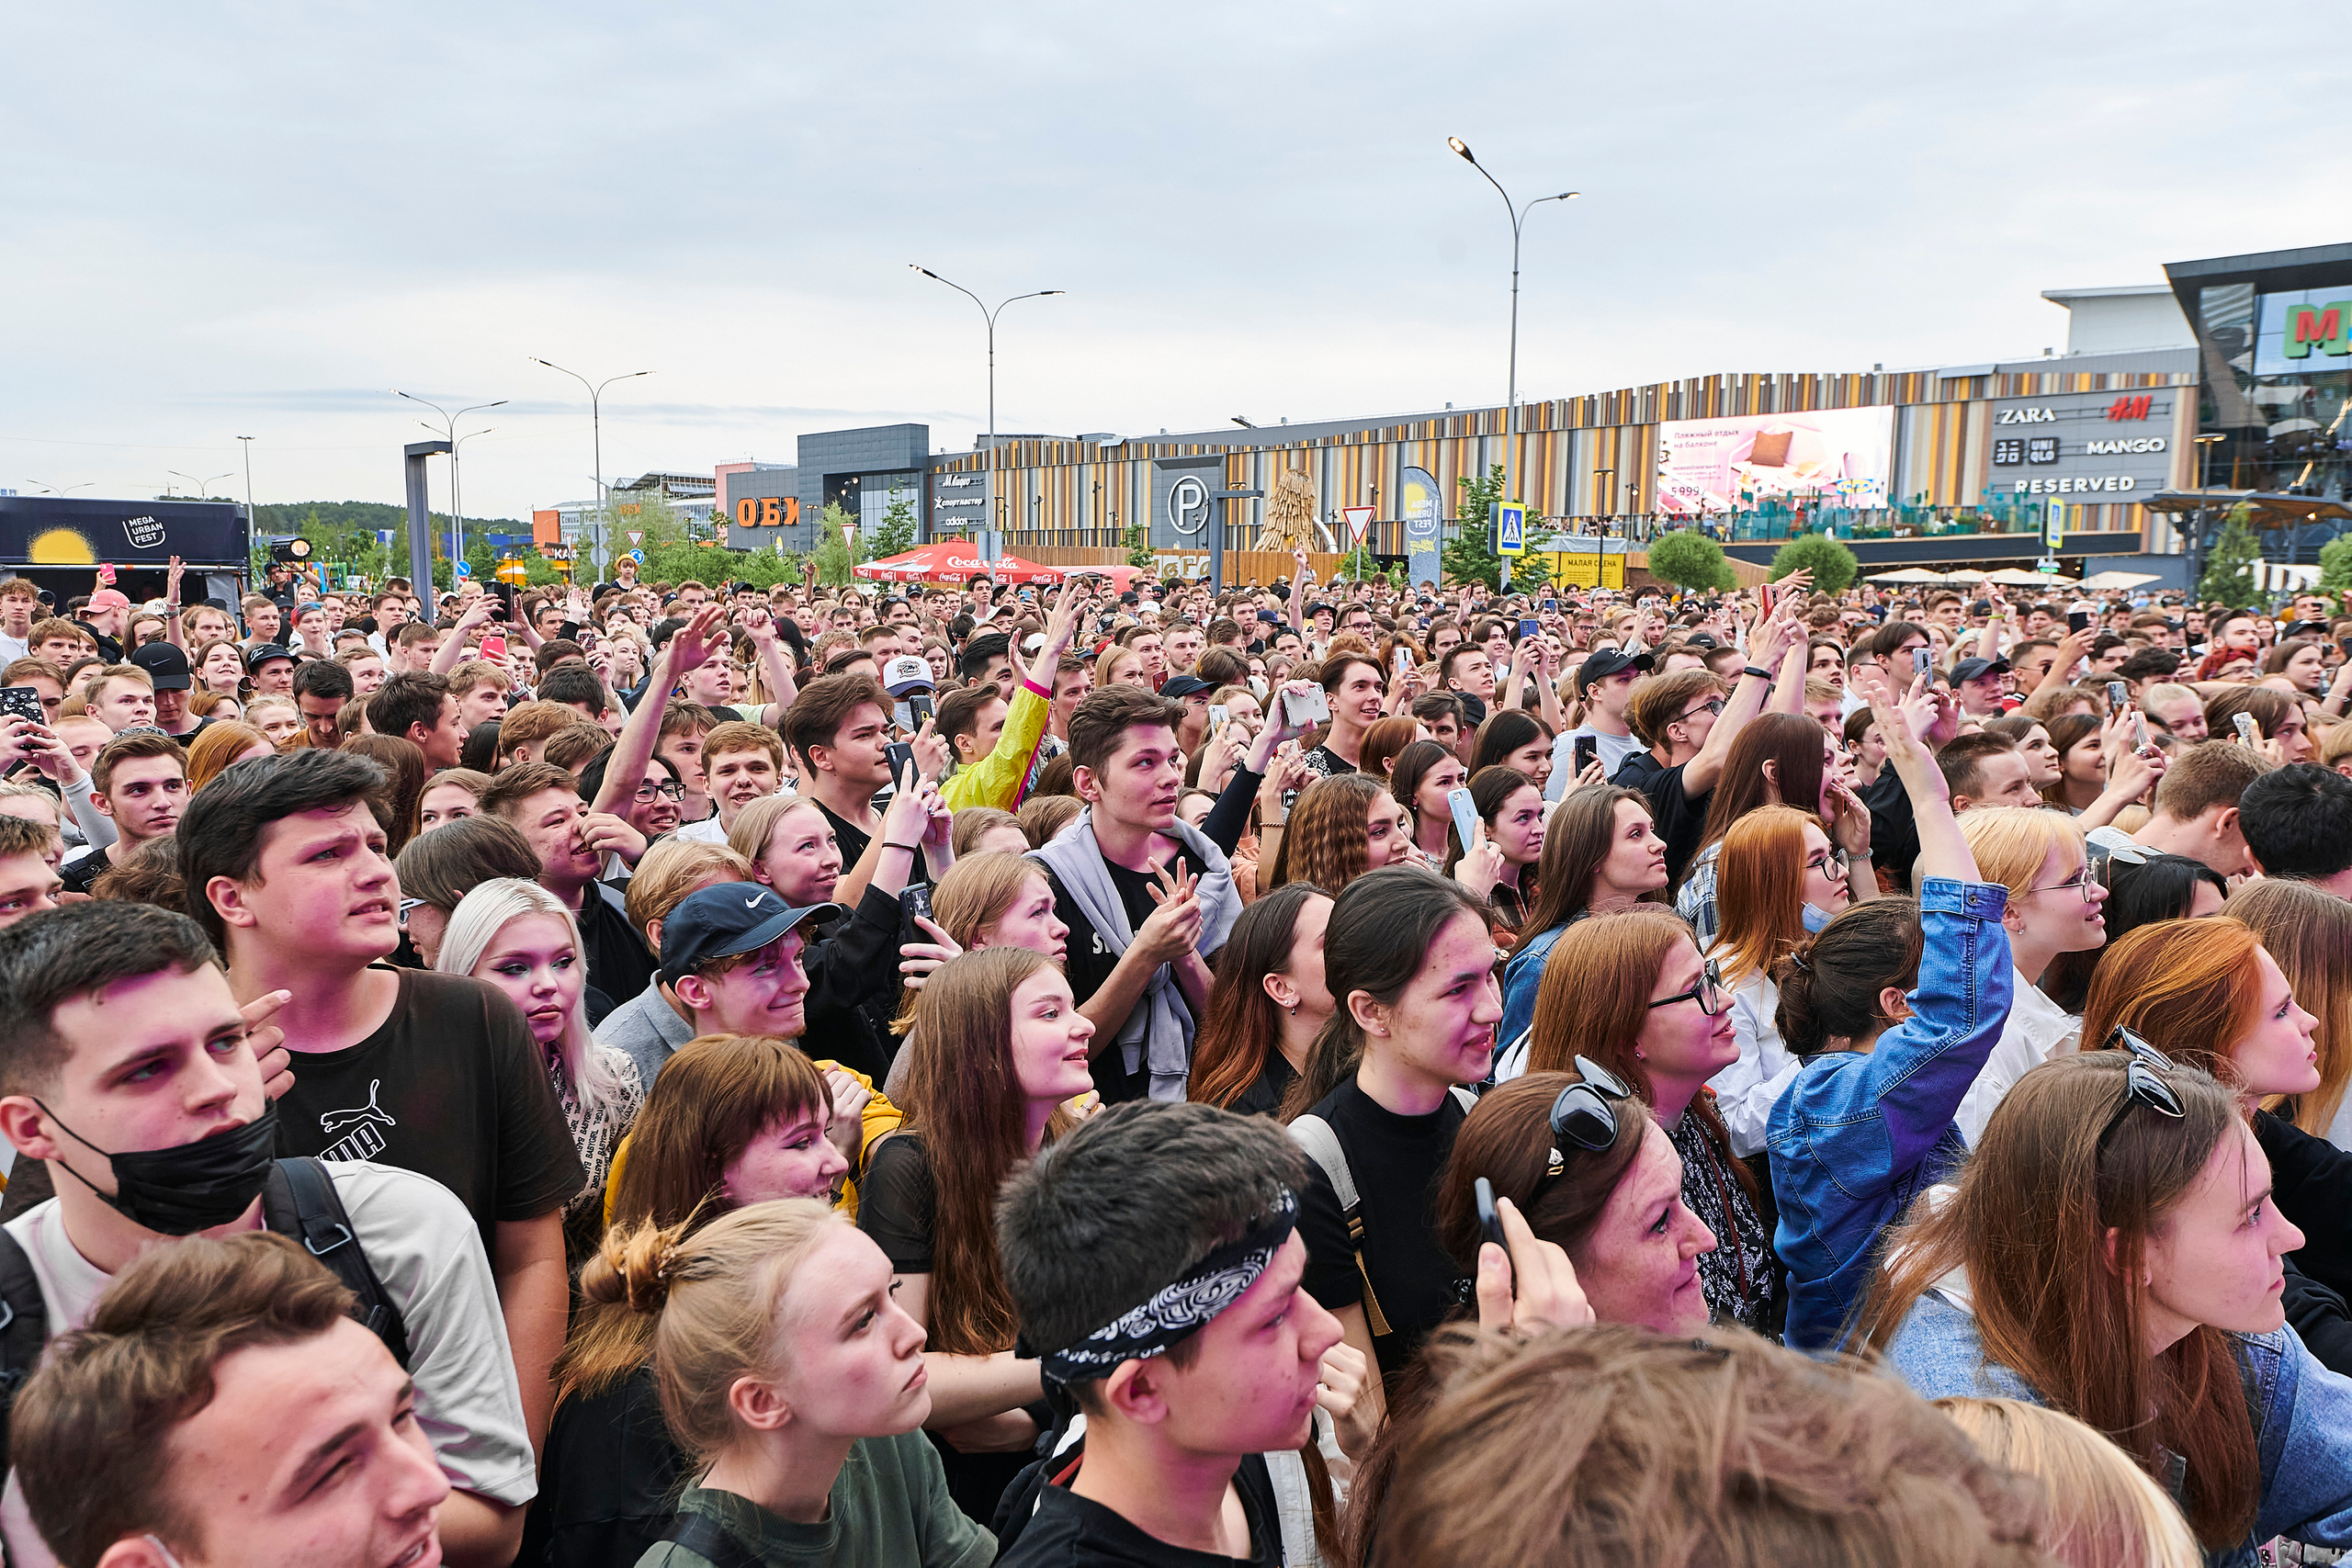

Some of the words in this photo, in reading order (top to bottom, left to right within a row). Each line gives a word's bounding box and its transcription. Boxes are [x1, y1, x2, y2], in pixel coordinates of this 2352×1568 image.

[2000, 407, 2057, 424] ZARA
[2108, 394, 2153, 422] H&M
[1674, 430, 1713, 439] Пляжный
[2030, 439, 2054, 450] UNI
[2086, 437, 2165, 455] MANGO
[2030, 450, 2055, 463] QLO
[2015, 476, 2135, 493] RESERVED
[737, 497, 799, 527] ОБИ
[129, 515, 155, 527] MEGA
[131, 522, 164, 535] URBAN
[946, 516, 968, 526] adidas
[134, 532, 157, 544] FEST
[585, 1128, 599, 1158] BABYGIRL
[590, 1158, 603, 1190] BABYGIRL
